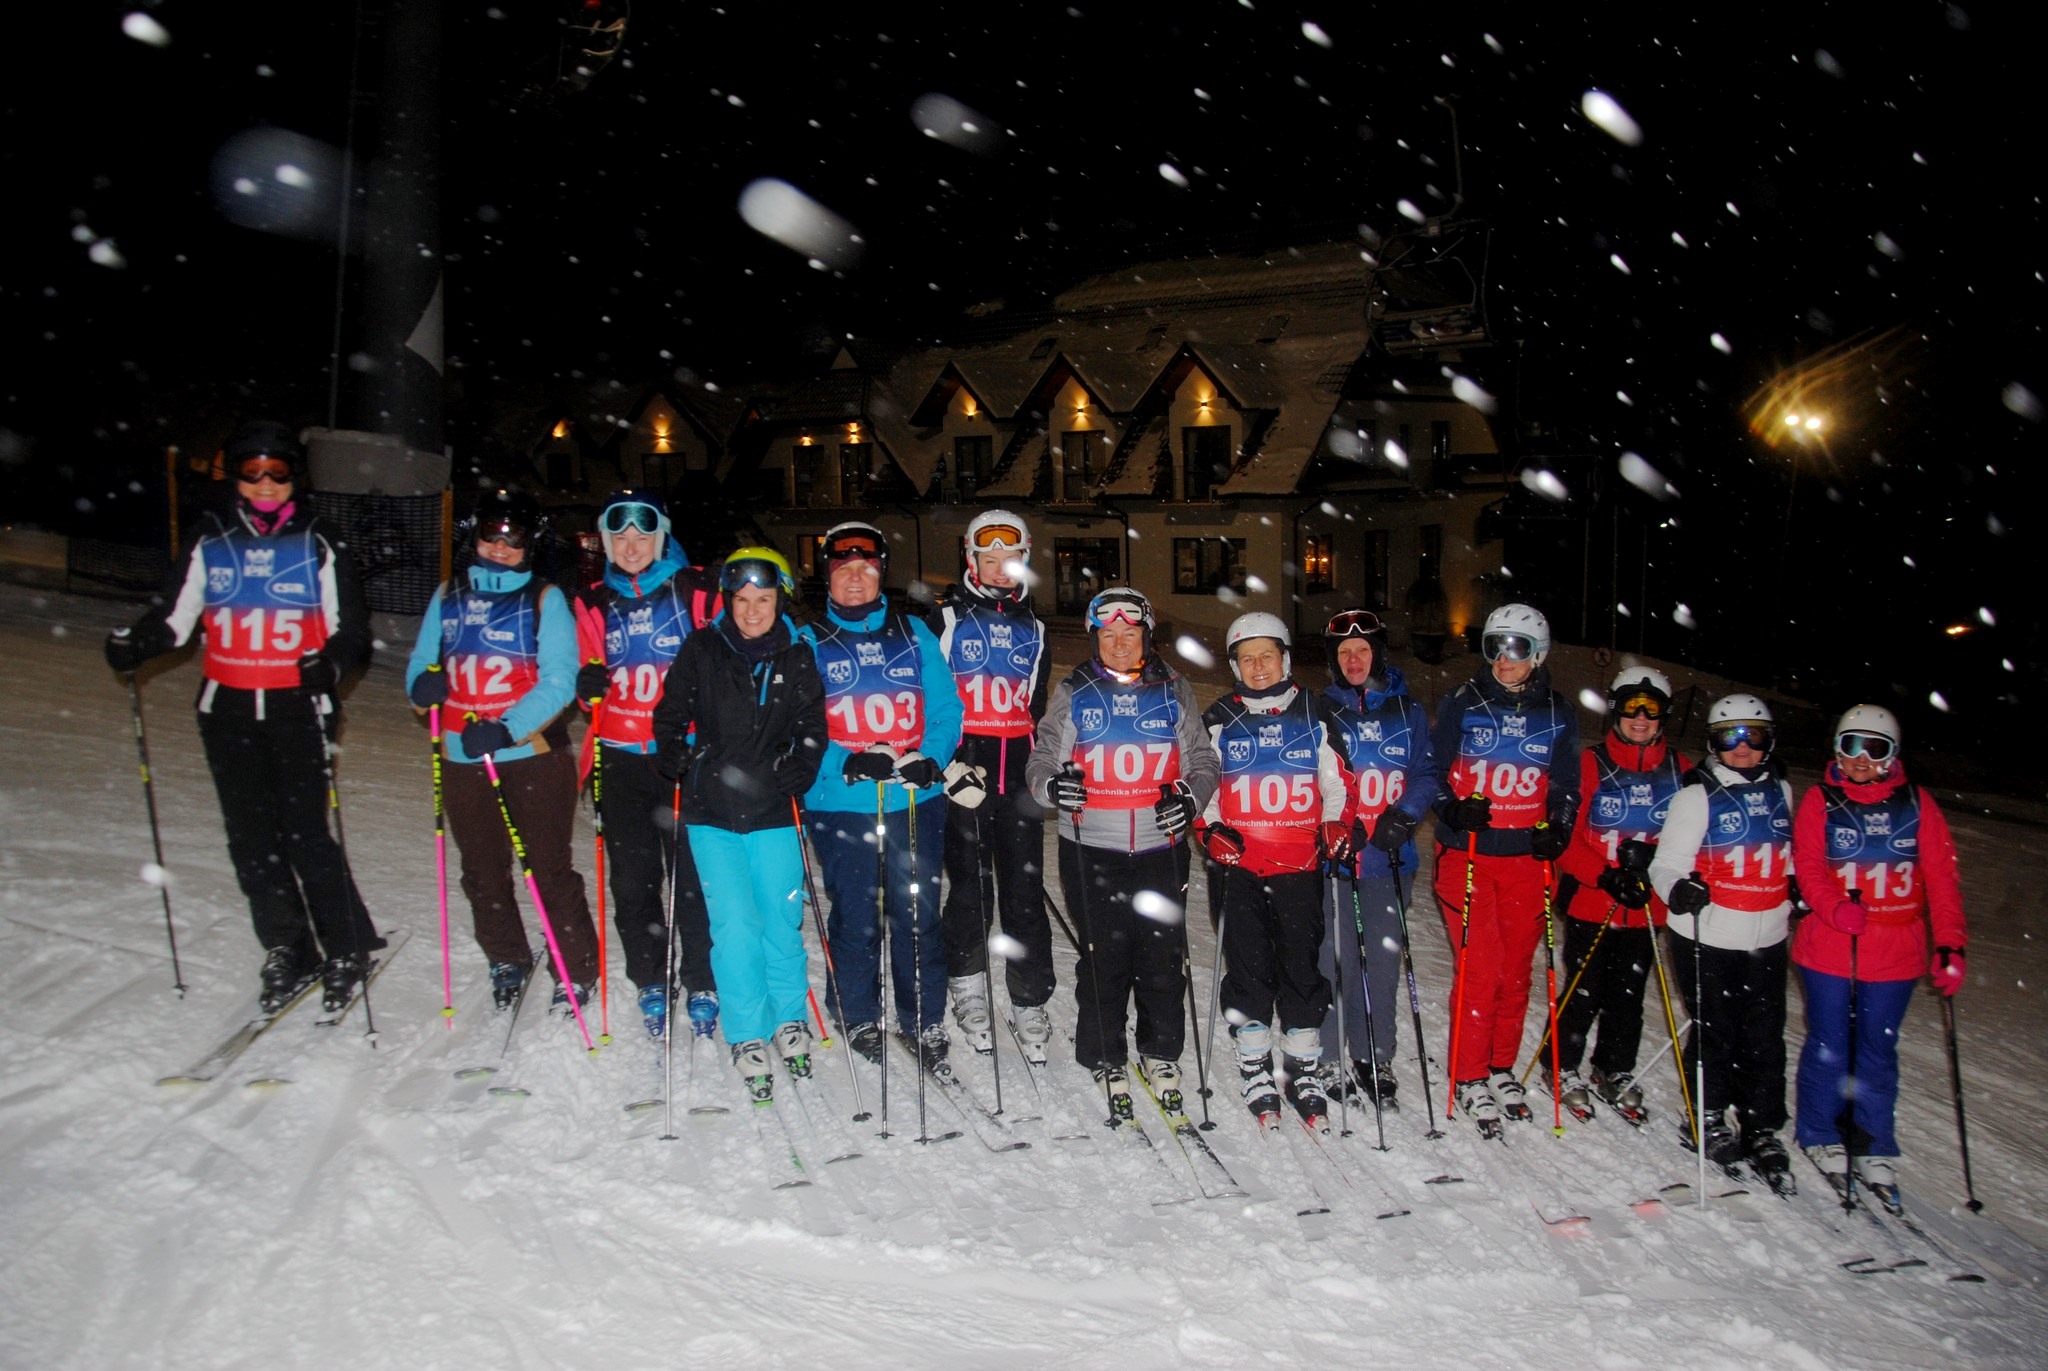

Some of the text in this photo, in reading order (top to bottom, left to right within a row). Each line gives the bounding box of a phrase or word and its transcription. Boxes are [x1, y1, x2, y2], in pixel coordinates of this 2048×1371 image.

[214, 607, 304, 651] 115
[447, 655, 512, 695] 112
[612, 664, 668, 702] 10
[966, 675, 1028, 713] 104
[828, 691, 917, 734] 103
[1085, 743, 1172, 783] 107
[1286, 749, 1311, 759] CSiR
[1231, 774, 1314, 813] 105
[1360, 769, 1404, 806] 06
[1470, 760, 1541, 797] 108
[1227, 818, 1315, 827] Politechnika Krakowska
[1837, 861, 1914, 898] 113
